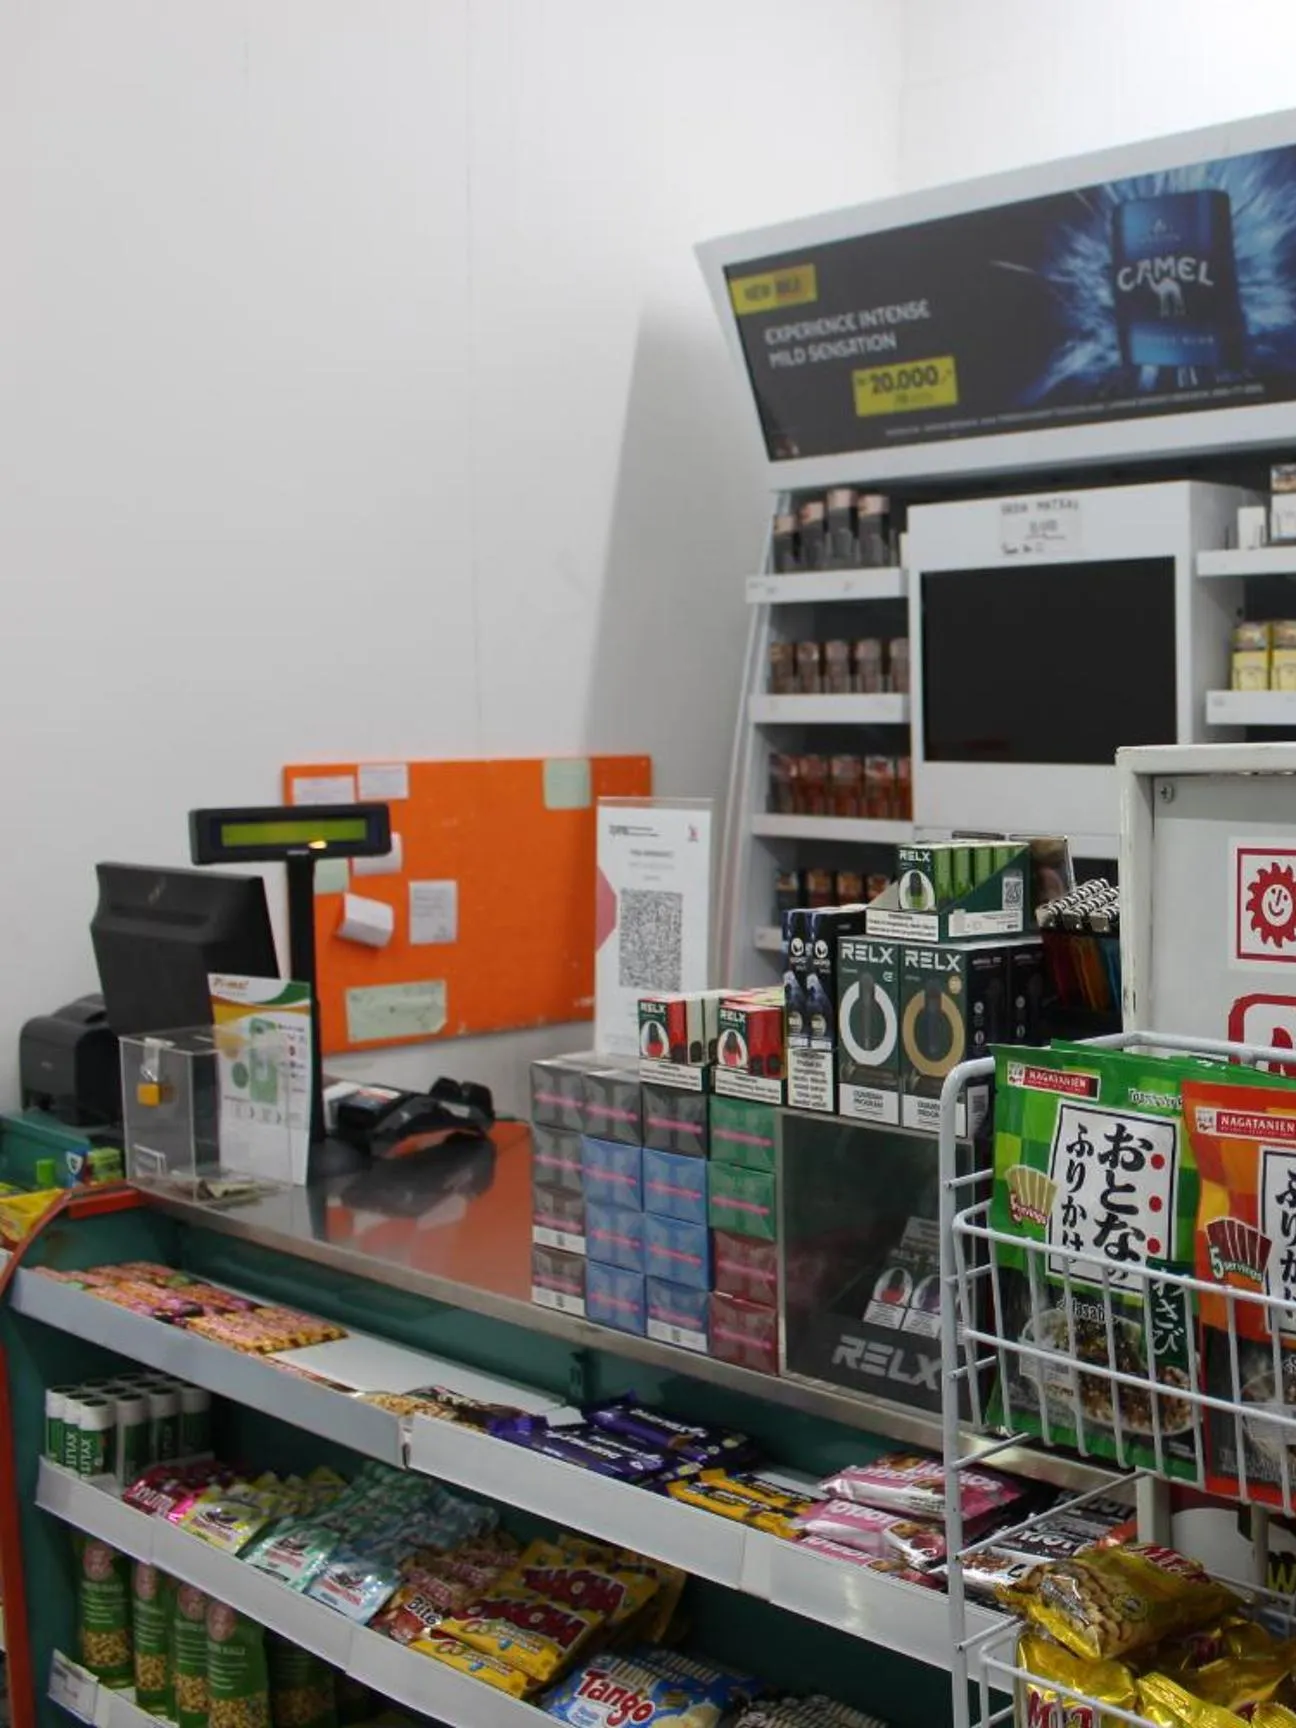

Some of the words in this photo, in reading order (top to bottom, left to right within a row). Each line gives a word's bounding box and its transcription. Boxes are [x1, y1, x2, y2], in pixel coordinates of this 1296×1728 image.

[1117, 256, 1214, 292] CAMEL
[764, 314, 856, 346] EXPERIENCE
[859, 299, 931, 327] INTENSE
[808, 332, 898, 362] SENSATION
[899, 849, 931, 863] RELX
[841, 941, 895, 965] RELX
[904, 949, 963, 973] RELX
[639, 1001, 667, 1014] RELX
[719, 1009, 747, 1024] RELX
[1220, 1115, 1296, 1133] NAGATANIEN
[1093, 1122, 1154, 1281] おとな
[1209, 1246, 1224, 1280] 5
[831, 1333, 942, 1392] RELX
[574, 1667, 657, 1727] Tango
